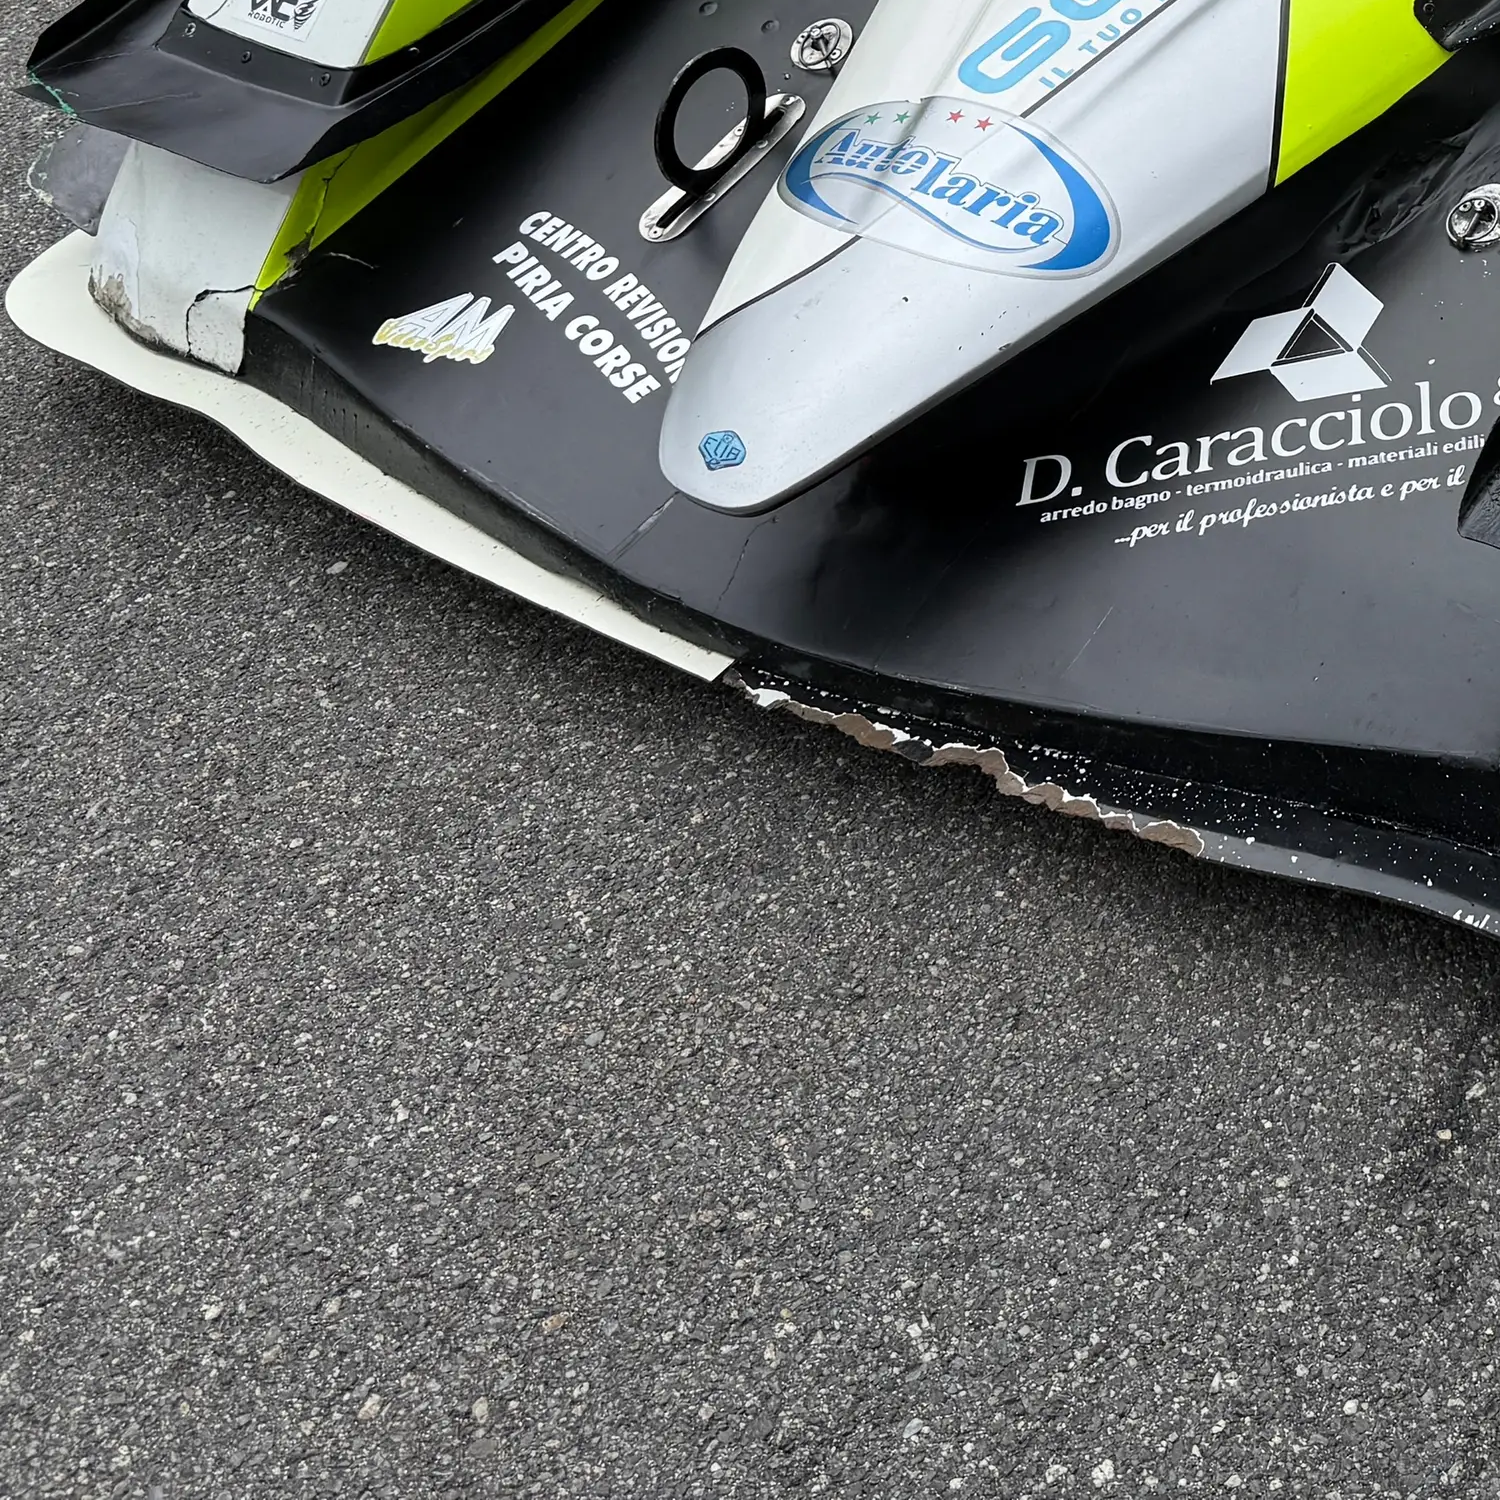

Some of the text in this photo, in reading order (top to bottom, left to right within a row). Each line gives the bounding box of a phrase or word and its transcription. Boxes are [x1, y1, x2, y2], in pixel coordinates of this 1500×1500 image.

[248, 11, 287, 30] ROBOTIC
[1039, 63, 1074, 90] IL
[1077, 7, 1143, 56] TUO
[519, 211, 620, 281] CENTRO
[492, 241, 661, 404] PIRIA CORSE
[1015, 453, 1083, 506] D.
[1105, 380, 1483, 489] Caracciolo
[1040, 433, 1486, 523] arredo bagno termoidraulica materiali edili
[1175, 509, 1196, 533] il
[1198, 484, 1375, 536] professionista
[1380, 483, 1395, 498] e
[1399, 476, 1441, 501] per
[1446, 464, 1466, 487] il
